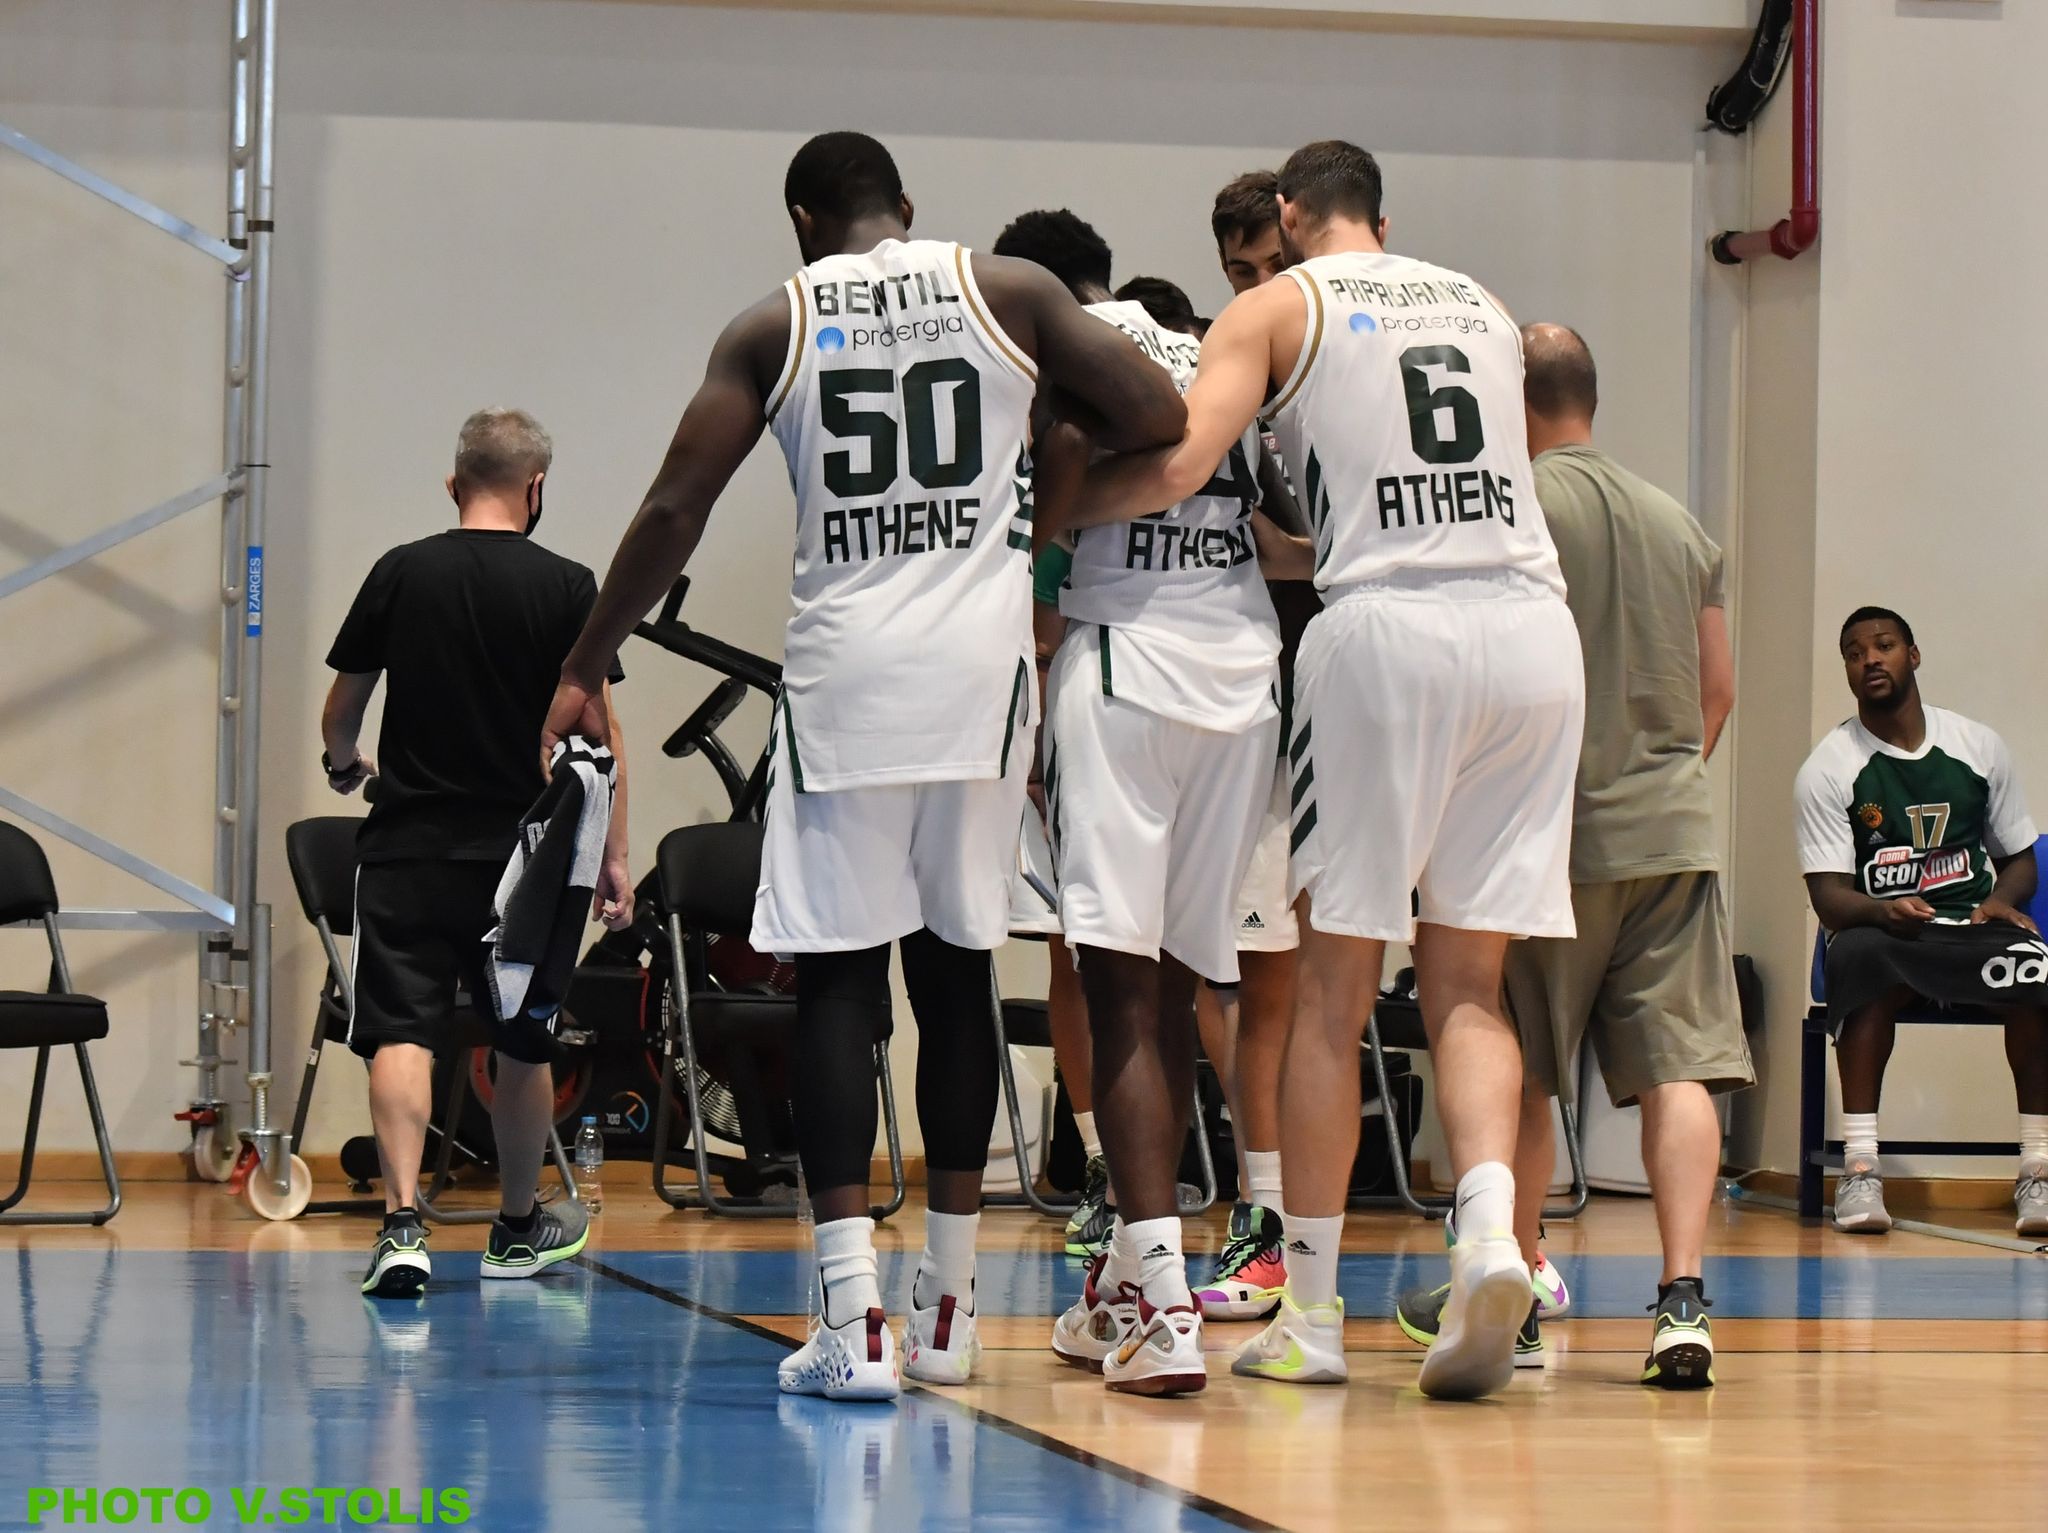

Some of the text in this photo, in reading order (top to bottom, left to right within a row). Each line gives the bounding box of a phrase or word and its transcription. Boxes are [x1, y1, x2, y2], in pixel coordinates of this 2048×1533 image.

[813, 271, 959, 316] BENTIL
[1328, 278, 1480, 307] PAPAGIANNIS
[852, 315, 963, 350] proergia
[1381, 314, 1488, 334] protergia
[818, 357, 983, 499] 50
[1399, 344, 1485, 465] 6
[1376, 470, 1515, 529] ATHENS
[824, 498, 981, 565] ATHENS
[249, 557, 261, 610] ZARGES
[1905, 802, 1951, 849] 17
